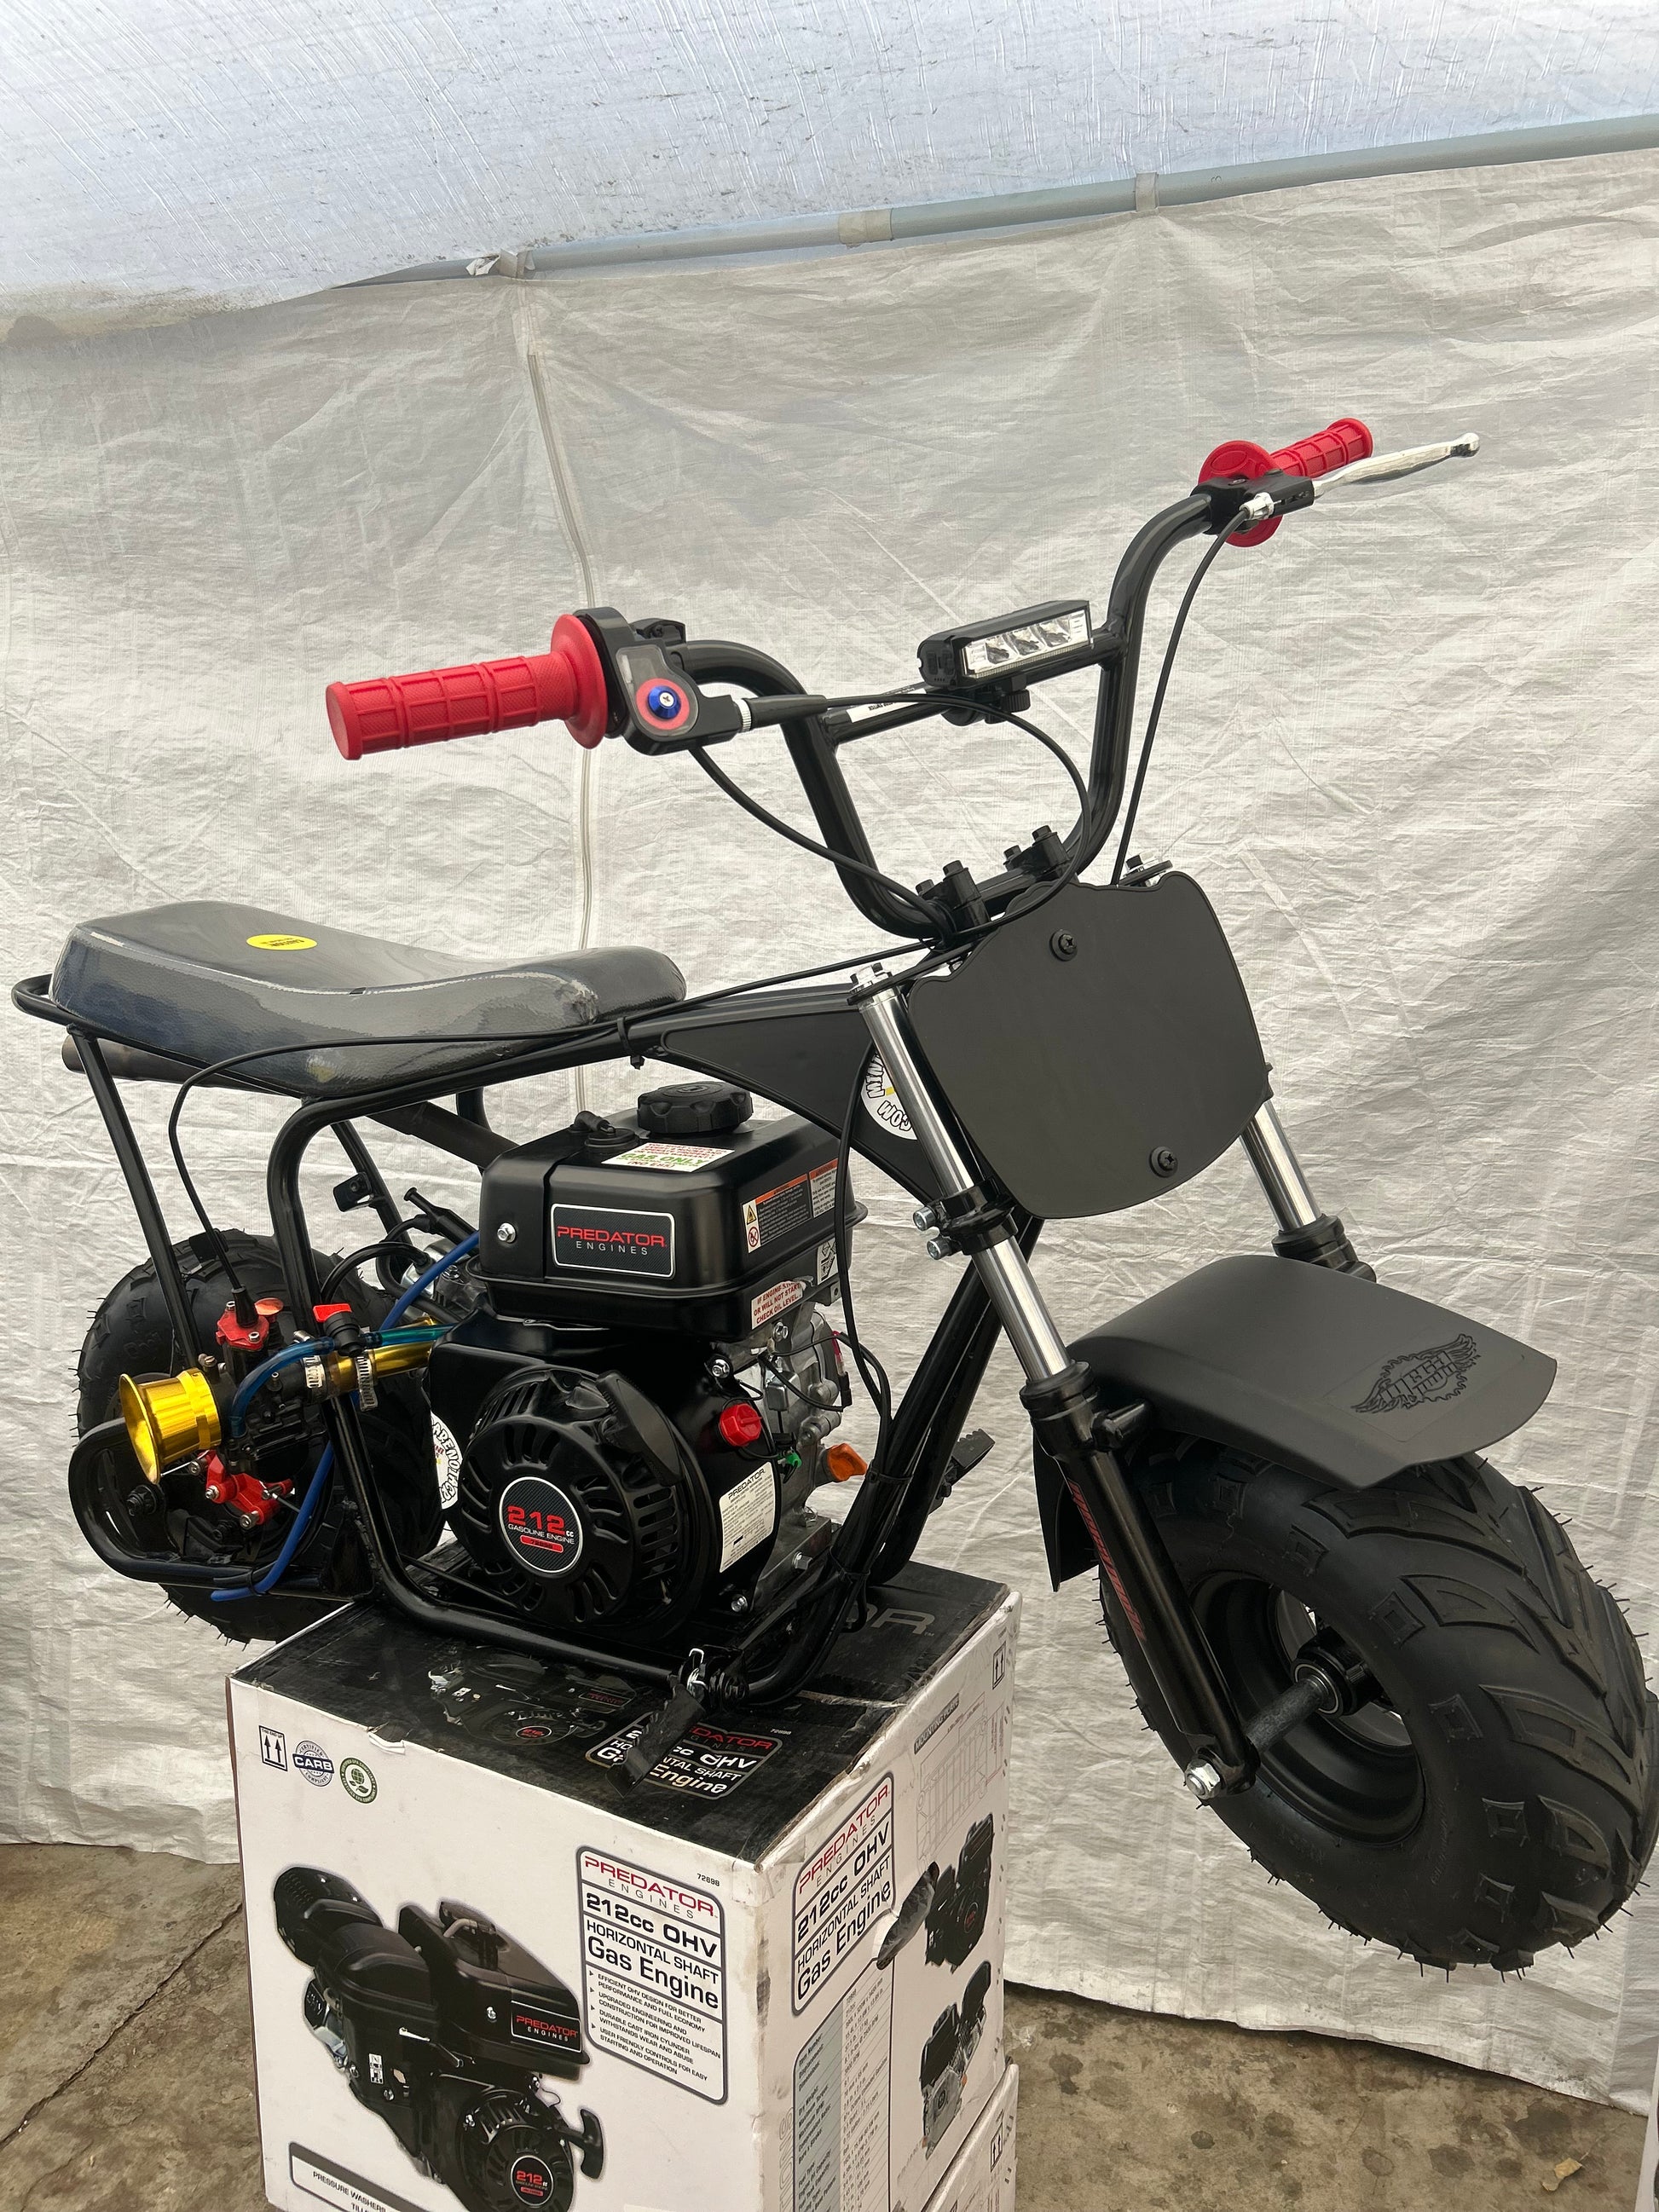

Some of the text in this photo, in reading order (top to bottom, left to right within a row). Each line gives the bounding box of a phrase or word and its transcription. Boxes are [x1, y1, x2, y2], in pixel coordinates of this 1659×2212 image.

[659, 1155, 709, 1165] ONLY
[557, 1226, 665, 1247] PREDATOR
[575, 1241, 648, 1256] ENGINES
[754, 1307, 760, 1316] OR
[761, 1301, 773, 1312] WILL
[774, 1292, 784, 1302] NOT
[763, 1285, 782, 1301] ENGINE
[756, 1308, 774, 1324] CHECK
[774, 1303, 783, 1313] OIL
[728, 1468, 766, 1500] PREDATOR
[508, 1523, 546, 1538] GASOLINE
[546, 1533, 575, 1545] ENGINE
[691, 1726, 772, 1750] DATOR
[294, 1756, 333, 1771] CARB
[649, 1764, 728, 1794] Engine
[694, 1767, 743, 1782] SHAFT
[699, 1753, 757, 1770] OHV
[799, 1784, 889, 1895] PREDATOR
[816, 1815, 876, 1888] ENGINES
[585, 1855, 714, 1917] PREDATOR
[608, 1878, 694, 1919] ENGINES
[797, 1822, 890, 1943] 212cc OHV
[586, 1892, 718, 1958] 212cc OHV
[797, 1894, 859, 1973] HORIZONTAL
[860, 1855, 891, 1897] SHAFT
[587, 1920, 719, 1984] HORIZONTAL SHAFT
[797, 1948, 831, 2001] Gas
[835, 1880, 892, 1955] Engine
[588, 1936, 719, 2009] Gas Engine
[598, 1973, 702, 2024] EFFICIENT OHV DESIGN FOR BETTER
[598, 1981, 706, 2032] PERFORMANCE AND FUEL ECONOMY
[598, 1991, 687, 2035] UPGRADED ENGINEERING AND
[516, 2015, 578, 2038] PREDATOR
[527, 2026, 569, 2042] ENGINES
[598, 1999, 721, 2059] CONSTRUCTION FOR IMPROVED LIFESPAN
[599, 2009, 691, 2054] DURABLE CAST IRON CYLINDER
[599, 2017, 694, 2064] WITHSTANDS WEAR AND ABUSE
[599, 2026, 708, 2081] USER FRIENDLY CONTROLS FOR EASY
[600, 2034, 678, 2074] STARTING AND OPERATION
[313, 2170, 350, 2195] PRESSURE
